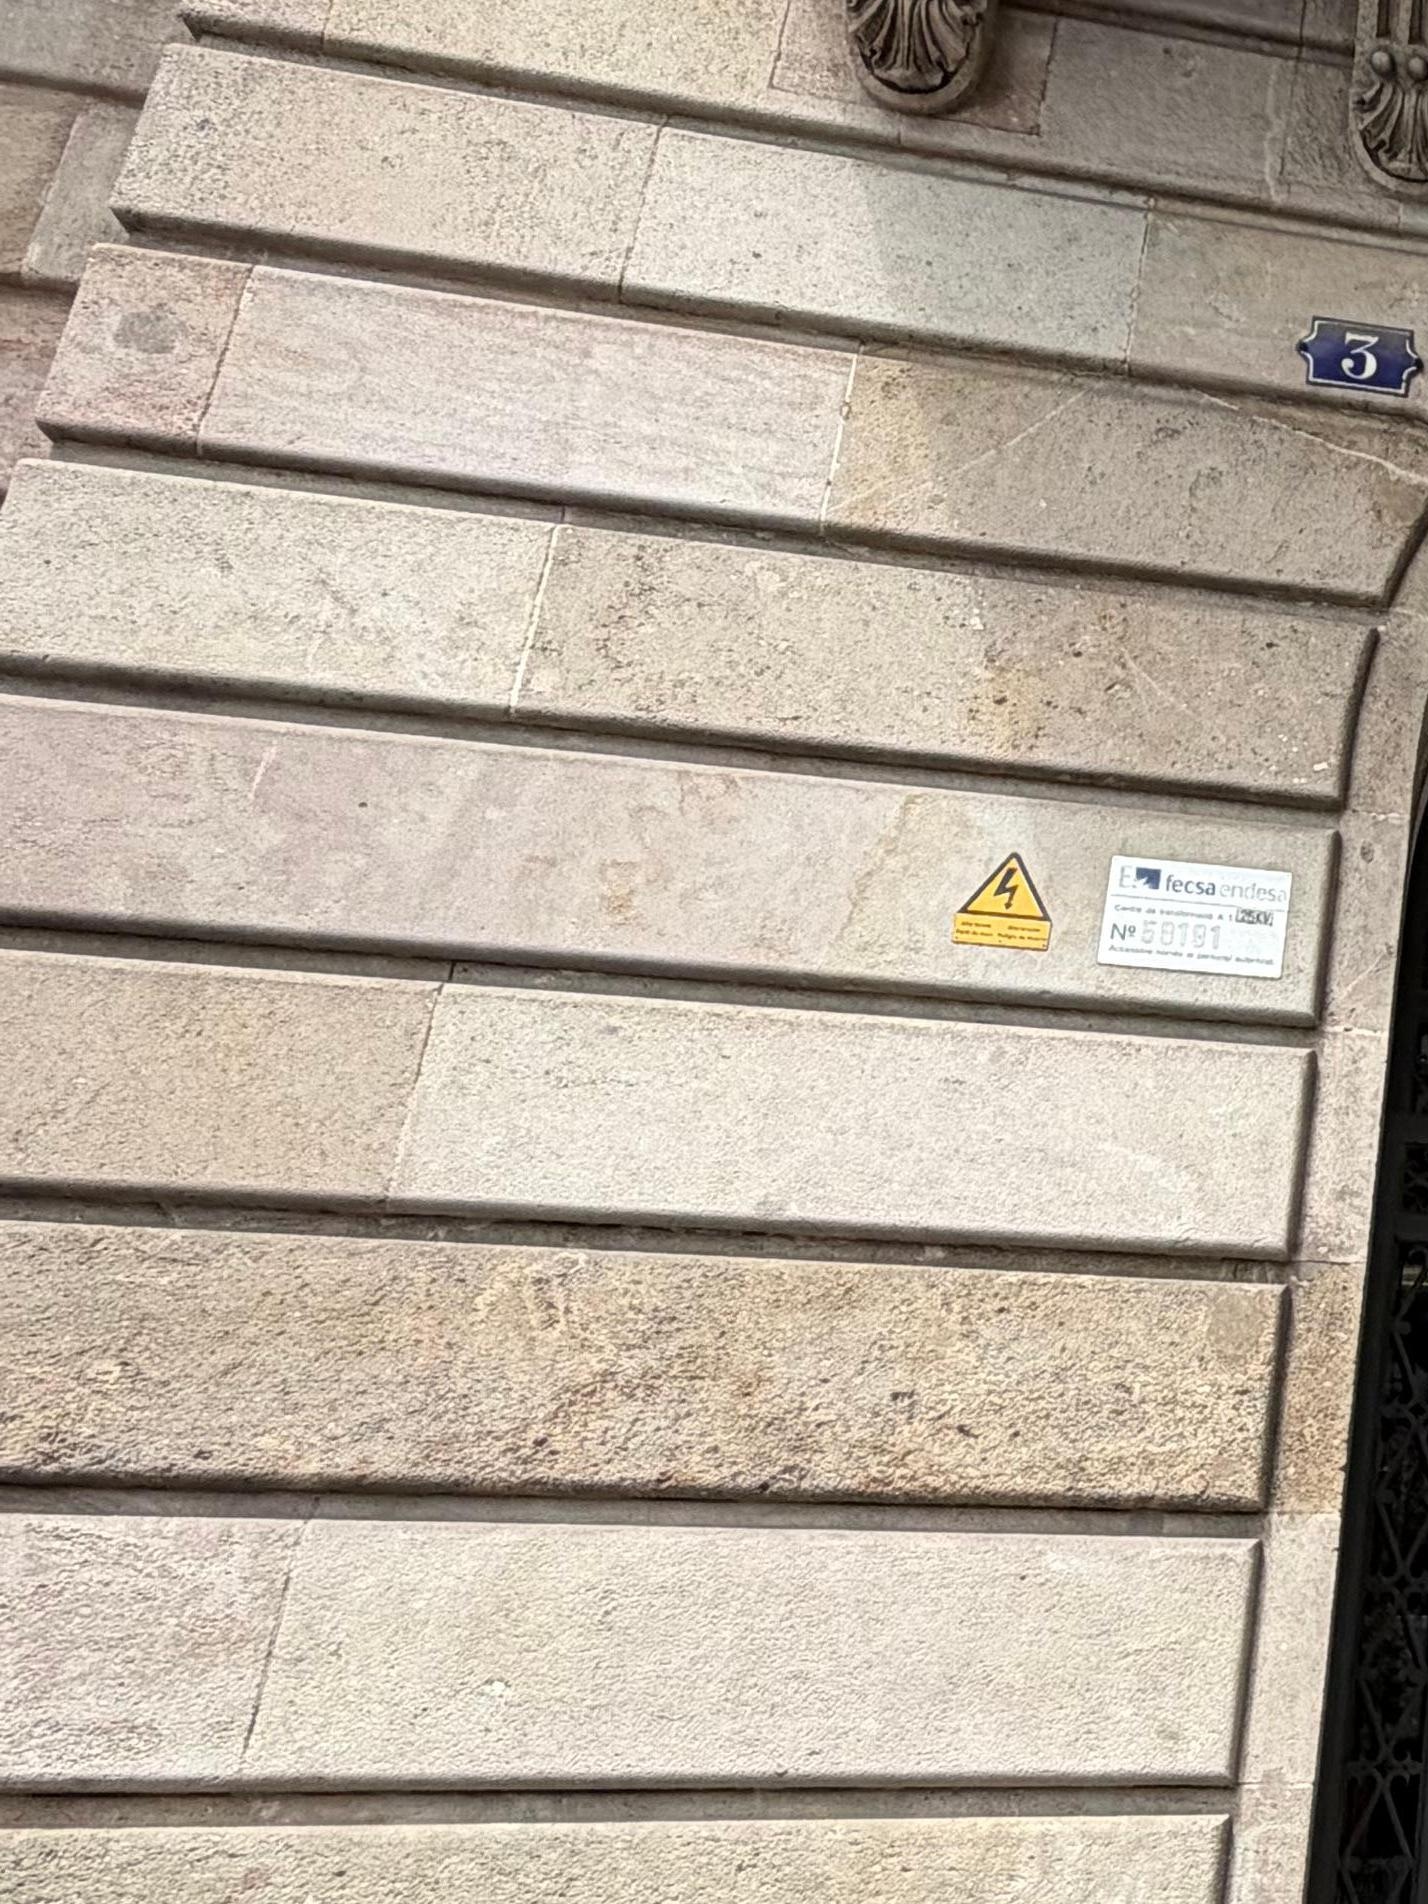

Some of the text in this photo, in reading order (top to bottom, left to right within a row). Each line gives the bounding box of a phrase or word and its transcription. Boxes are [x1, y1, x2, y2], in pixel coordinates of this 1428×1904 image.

[1341, 332, 1379, 379] 3
[1165, 874, 1216, 897] fecsa
[1219, 881, 1288, 903] endesa
